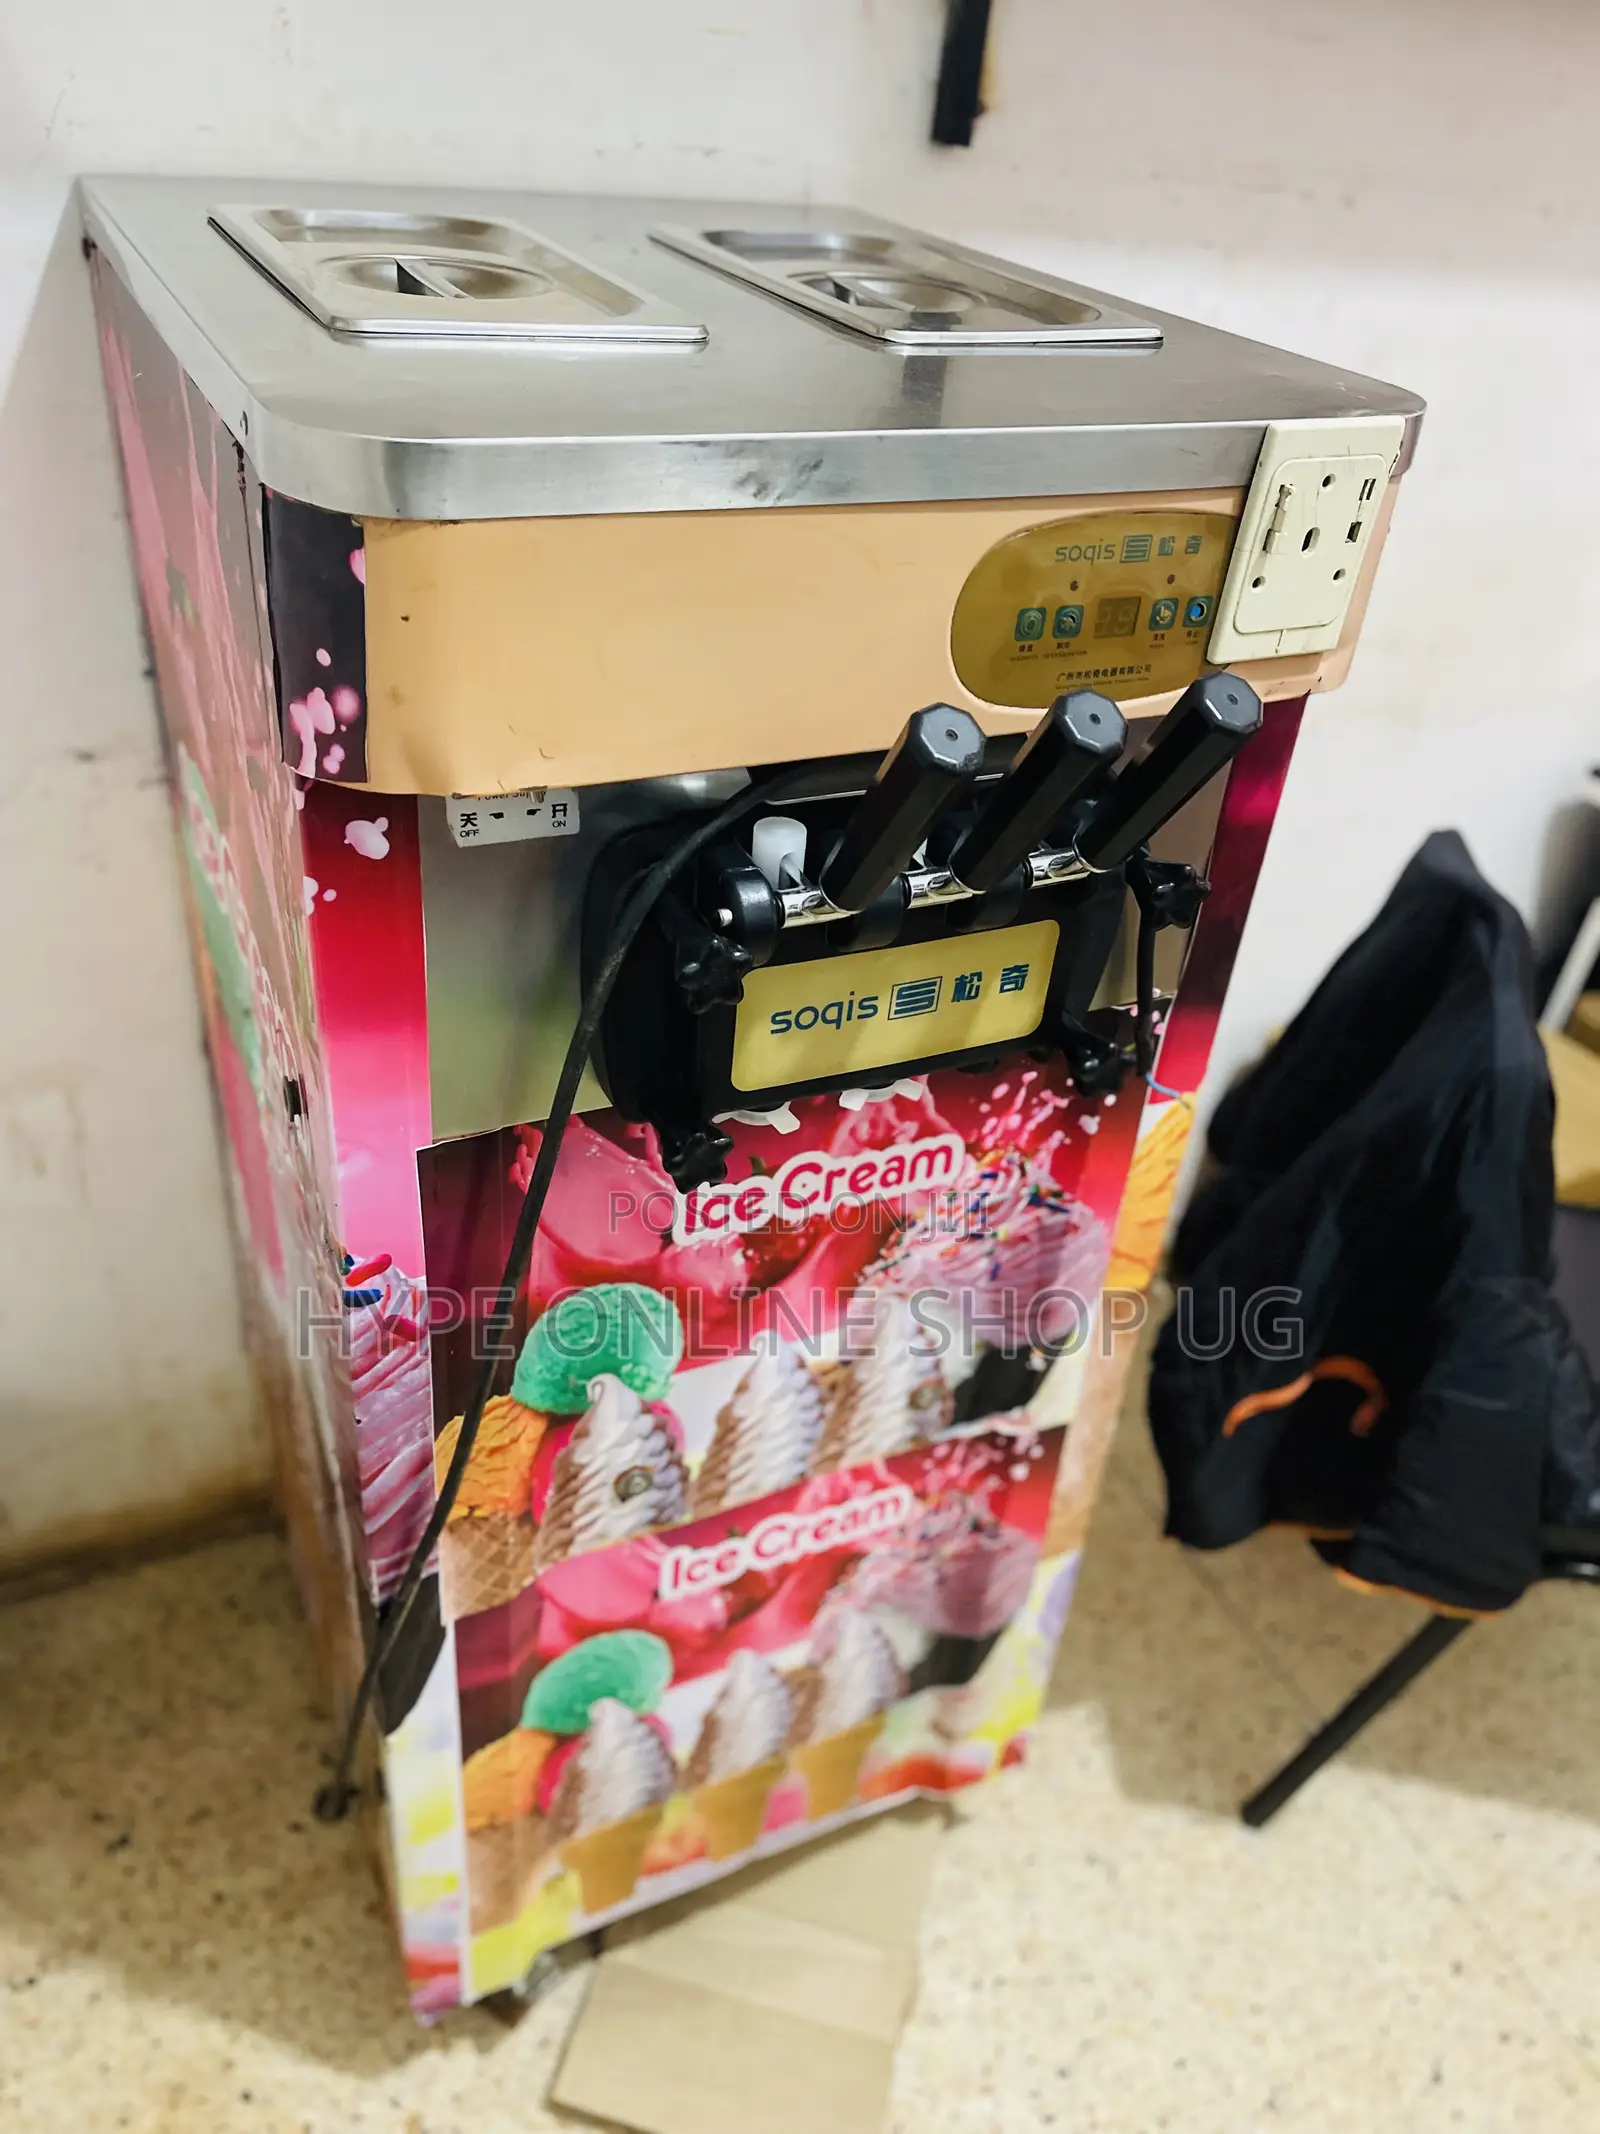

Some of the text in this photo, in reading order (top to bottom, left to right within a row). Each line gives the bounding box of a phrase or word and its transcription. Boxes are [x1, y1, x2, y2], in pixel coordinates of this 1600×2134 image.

[1055, 539, 1116, 565] soqis
[459, 820, 567, 838] OFF ON
[770, 991, 878, 1034] soqis
[684, 1143, 954, 1236] Ice Cream
[672, 1495, 902, 1590] Ice Cream
